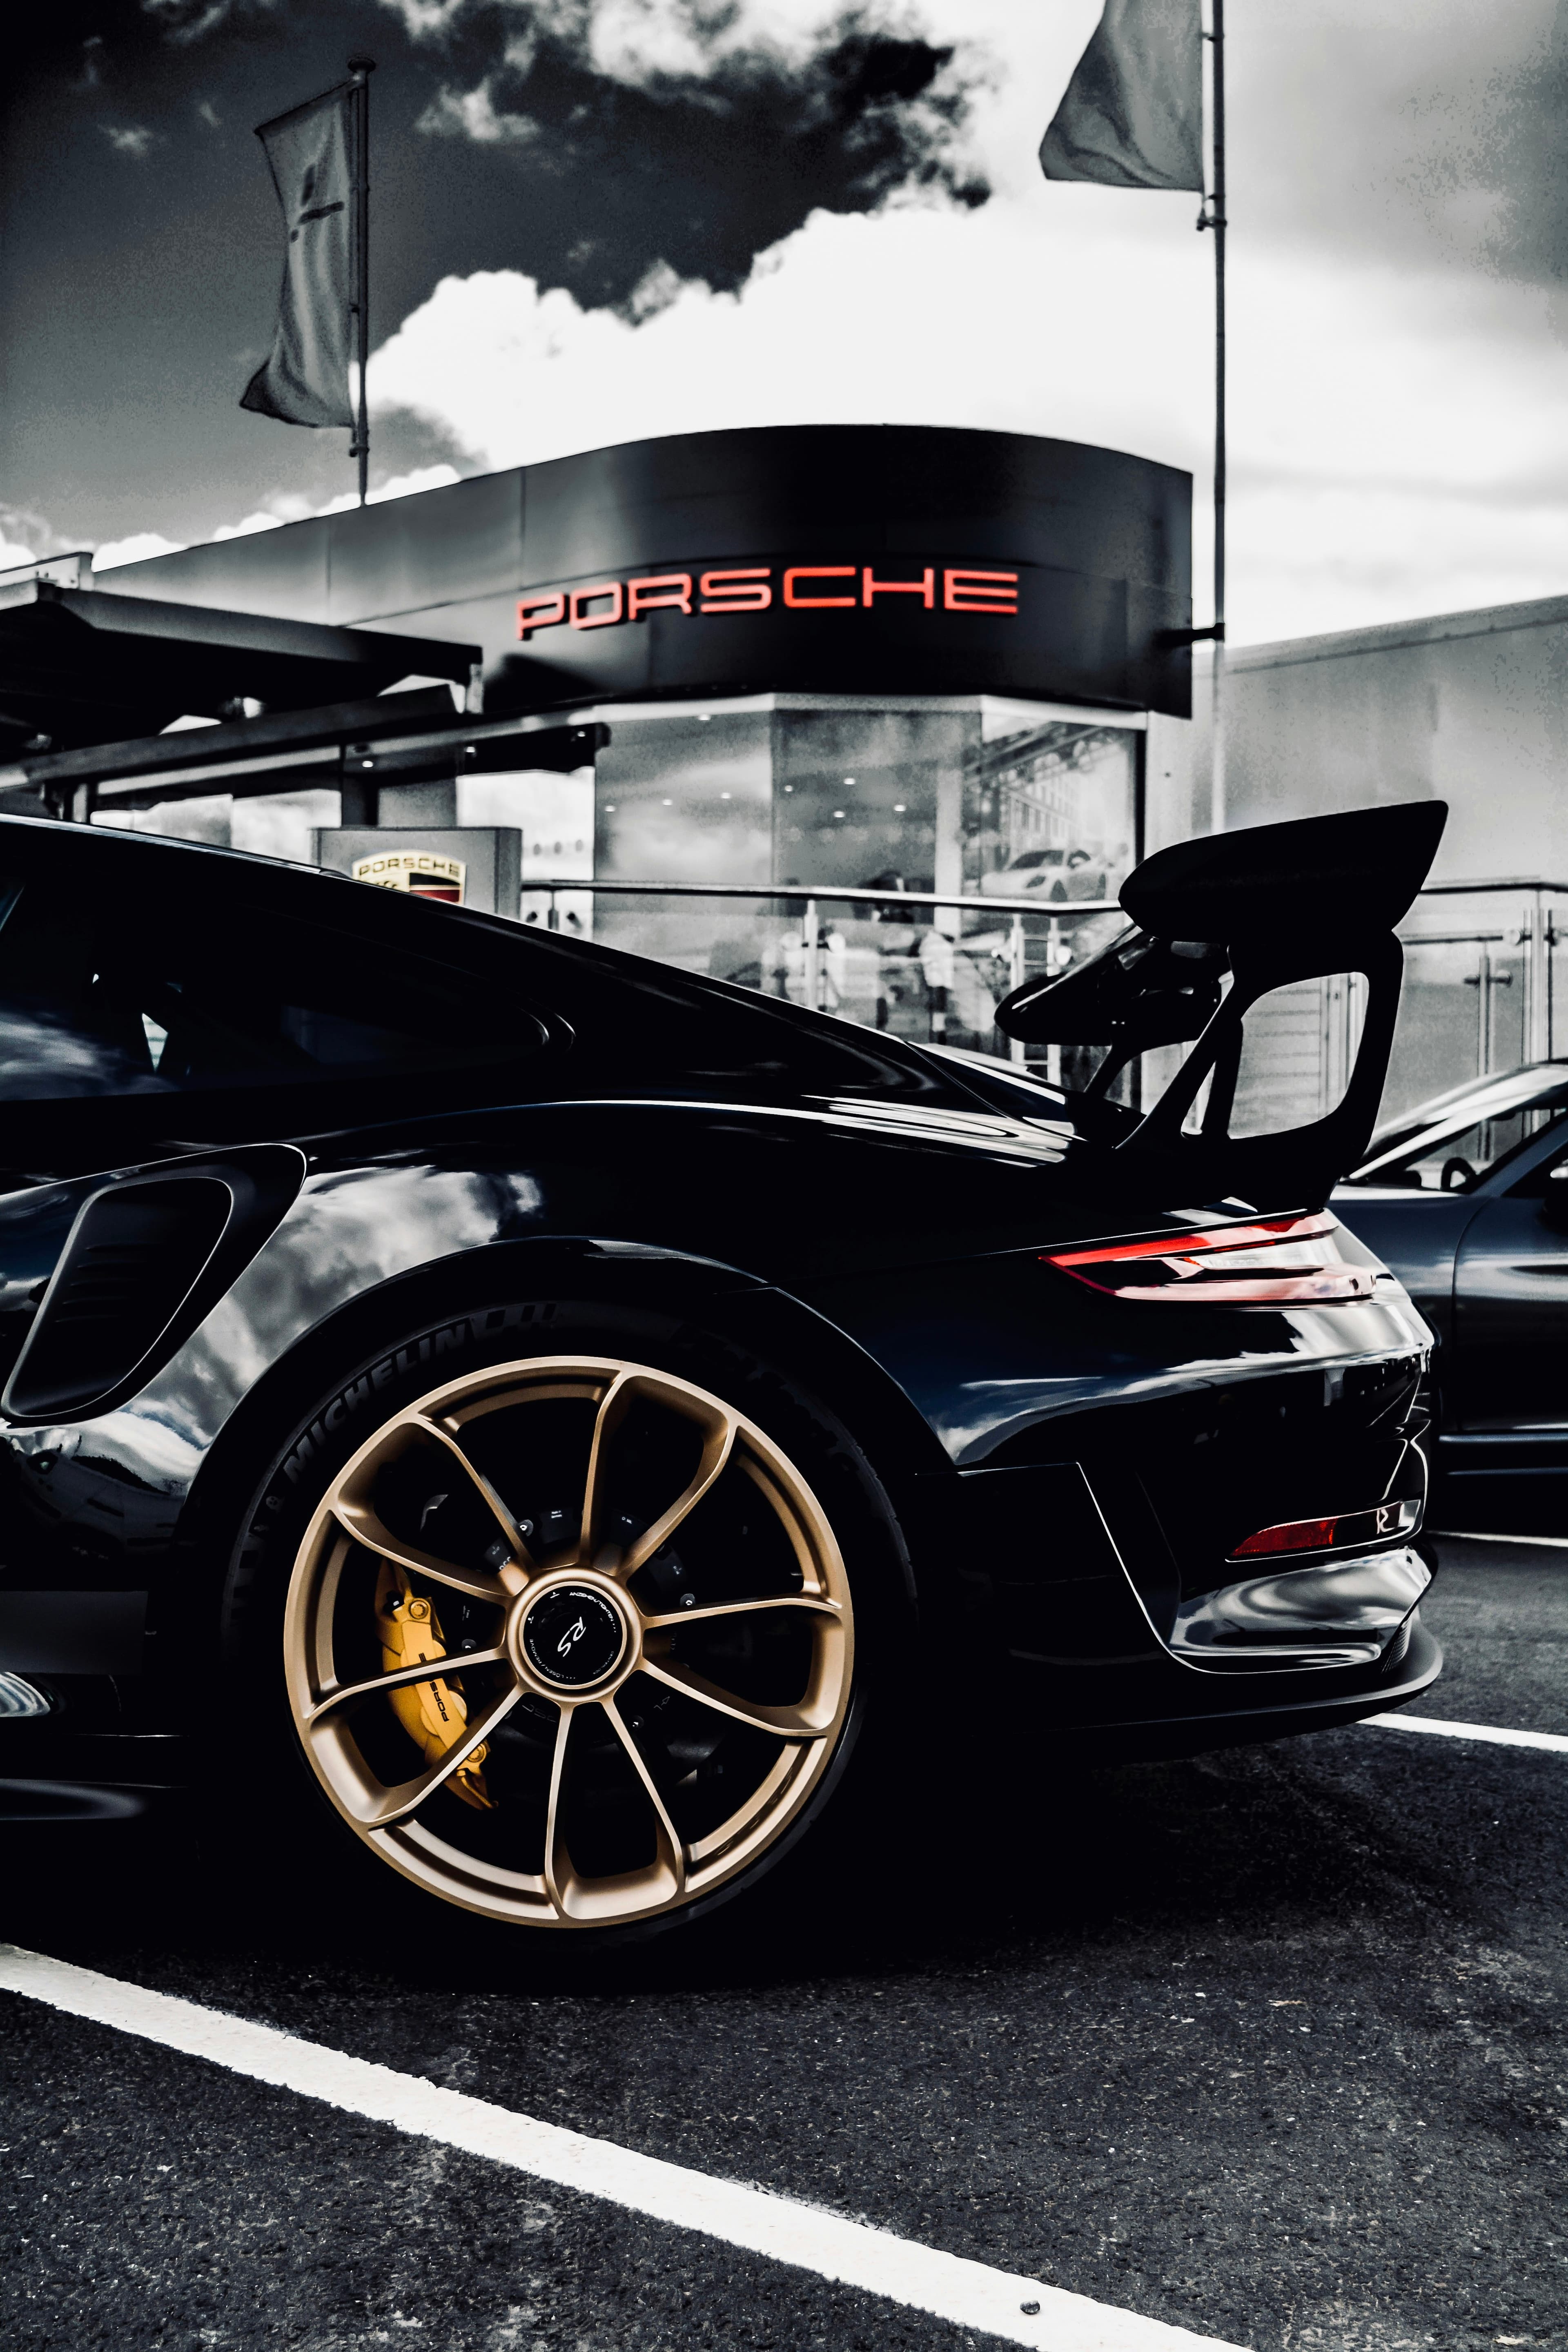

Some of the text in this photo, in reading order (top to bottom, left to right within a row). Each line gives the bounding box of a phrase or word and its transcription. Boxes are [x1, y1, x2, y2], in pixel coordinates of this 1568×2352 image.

[516, 567, 1018, 640] PORSCHE
[359, 858, 459, 878] PORSCHE
[283, 1323, 467, 1485] MICHELIN
[557, 1616, 586, 1657] RS
[419, 1653, 450, 1722] PORSE
